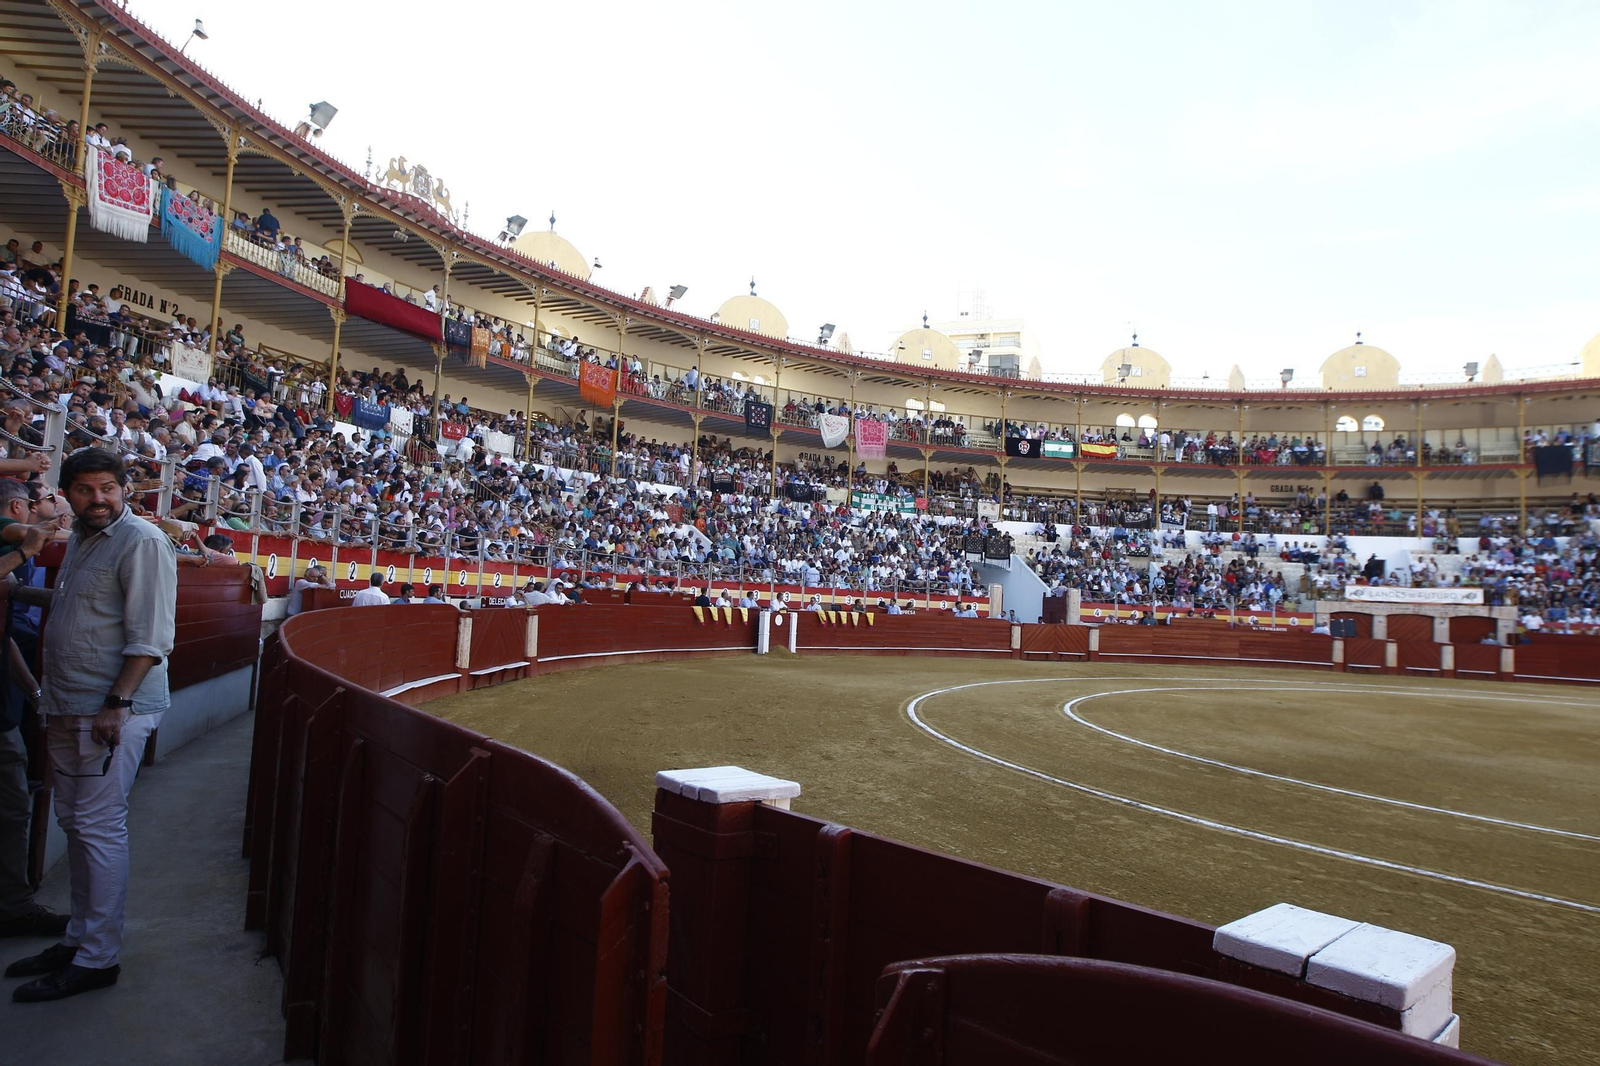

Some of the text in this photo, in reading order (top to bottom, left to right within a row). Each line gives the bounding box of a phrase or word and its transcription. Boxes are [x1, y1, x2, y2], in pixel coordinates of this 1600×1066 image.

[117, 284, 154, 309] GRADA
[268, 555, 276, 577] 2
[349, 562, 357, 580] 2
[388, 566, 395, 583] 2
[424, 568, 431, 584] 2
[460, 570, 466, 586] 2
[494, 573, 501, 587] 2
[784, 592, 790, 602] 3
[846, 596, 852, 605] 3
[1369, 591, 1407, 599] LANCES
[1418, 592, 1458, 600] FUTURO
